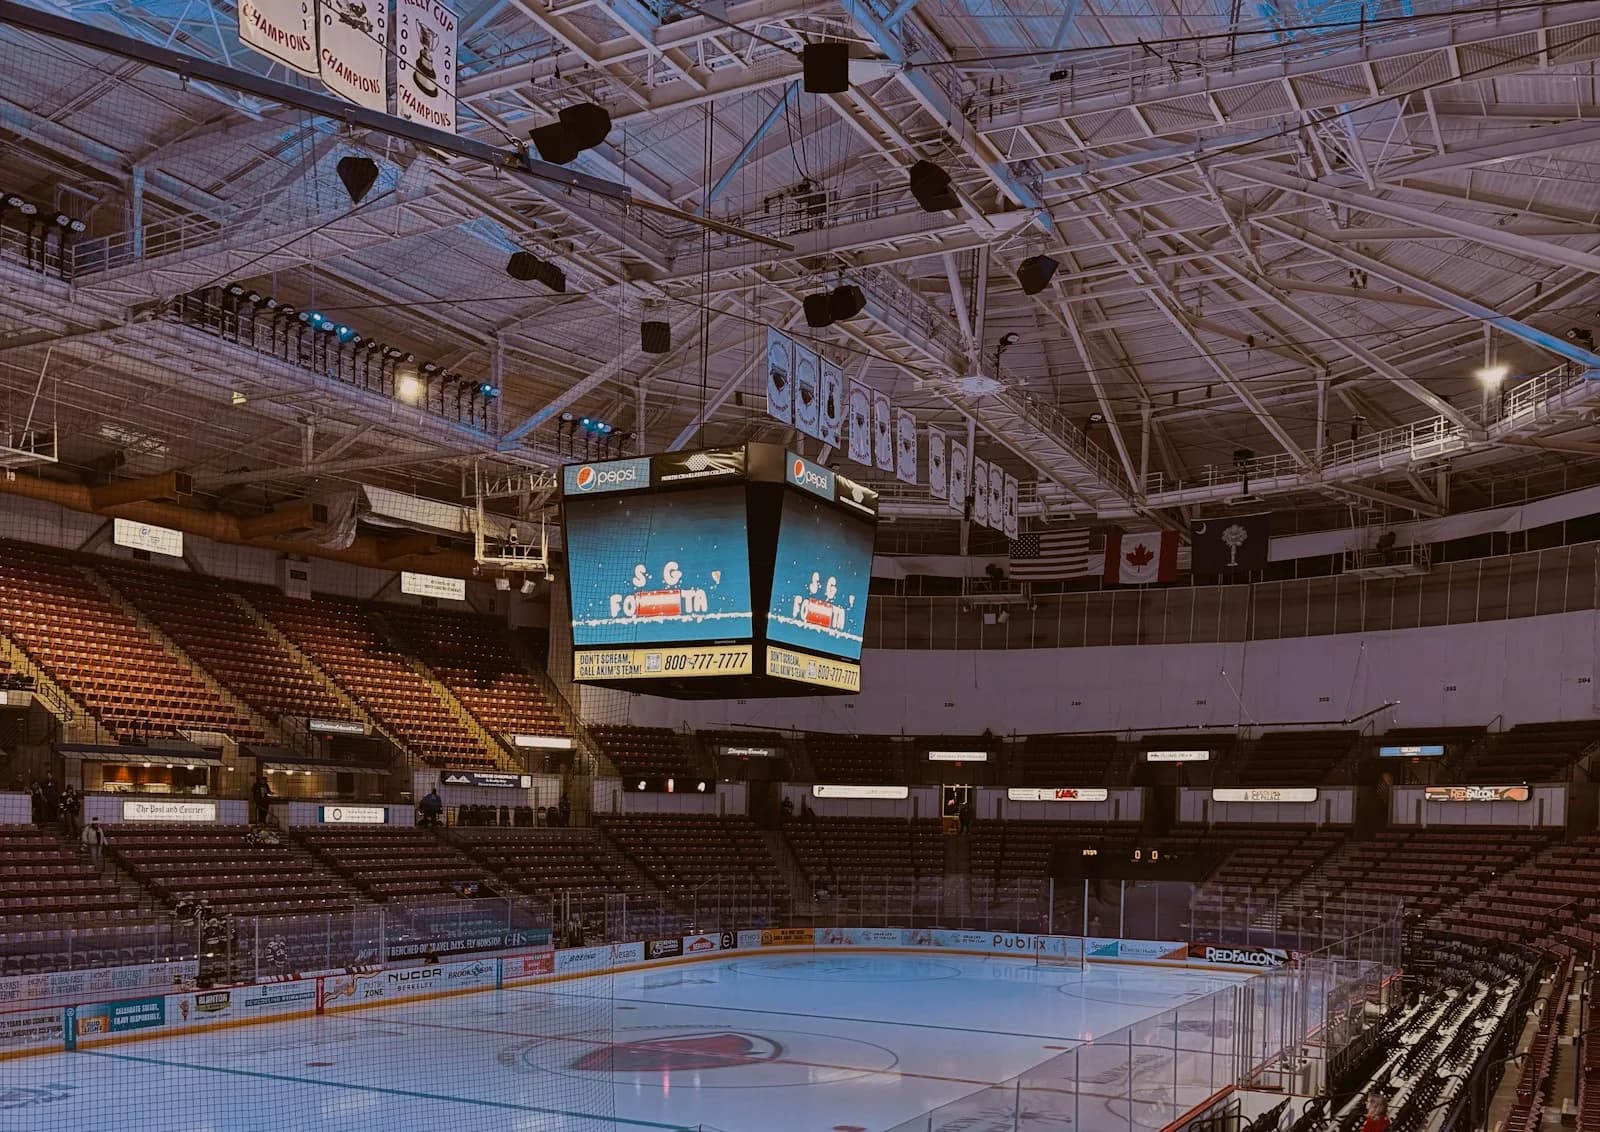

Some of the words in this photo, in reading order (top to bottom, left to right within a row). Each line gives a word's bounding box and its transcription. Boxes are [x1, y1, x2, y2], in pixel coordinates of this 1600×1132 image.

[243, 4, 311, 51] CHAMPIONS
[433, 5, 454, 32] CUP
[399, 14, 409, 70] 2000
[322, 48, 381, 94] CHAMPIONS
[399, 84, 452, 127] CHAMPIONS
[597, 467, 637, 484] pepsi
[805, 471, 828, 490] pepsi
[579, 654, 600, 665] DON'T
[664, 652, 748, 671] 800-777-7777
[579, 667, 594, 676] CALL
[596, 664, 621, 676] AKIM'S
[622, 663, 642, 676] TEAM!
[136, 804, 148, 814] The
[166, 806, 178, 814] and
[391, 942, 419, 957] BENCHED
[467, 939, 476, 949] FLY
[993, 935, 1046, 951] Publix
[1206, 946, 1275, 965] REDFALCON
[388, 968, 442, 983] NUCOR
[364, 988, 385, 998] ZONE
[397, 981, 433, 992] BERKELEY
